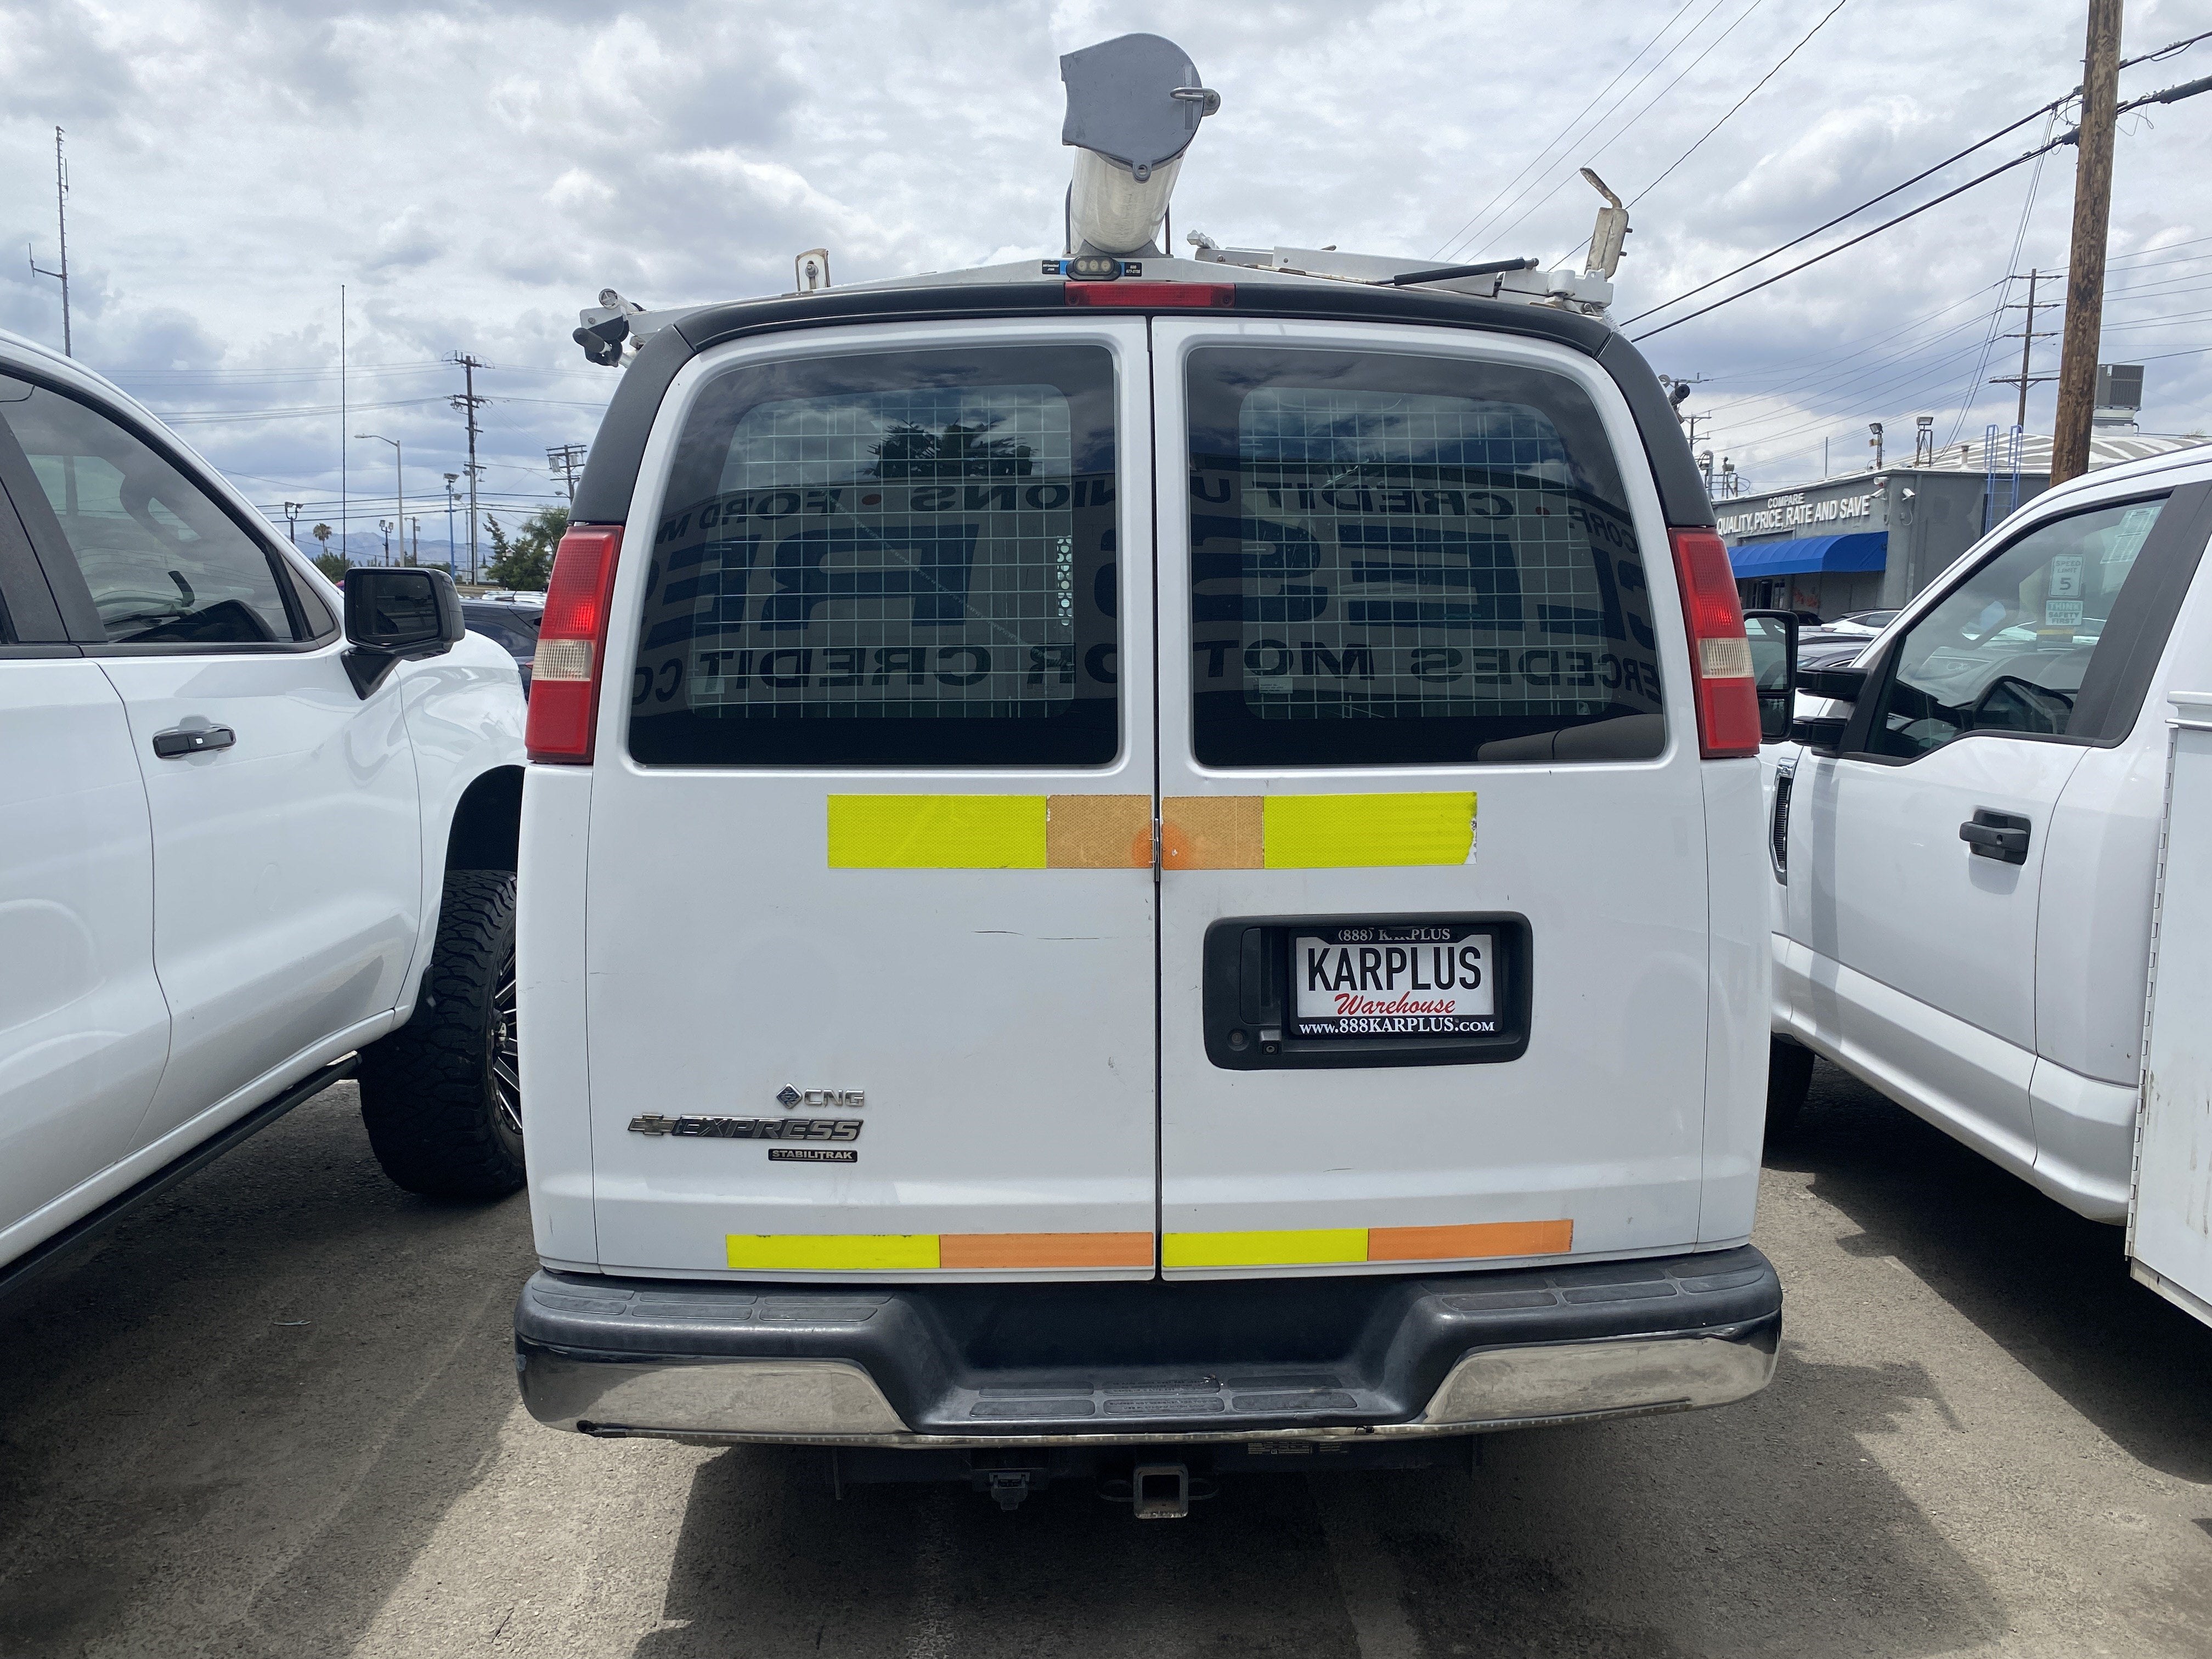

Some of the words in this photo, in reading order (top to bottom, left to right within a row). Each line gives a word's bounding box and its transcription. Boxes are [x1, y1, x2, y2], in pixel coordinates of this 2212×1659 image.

[1768, 493, 1804, 509] COMPARE
[1754, 508, 1783, 531] PRICE,
[1786, 504, 1813, 526] RATE
[1814, 500, 1838, 522] AND
[1840, 495, 1871, 519] SAVE
[2059, 577, 2071, 590] 5
[2047, 602, 2081, 611] THINK
[1338, 928, 1373, 941] (888)
[1378, 928, 1451, 941] KPLUS
[1308, 946, 1481, 991] KARPLUS
[1334, 991, 1455, 1015] Warehouse
[804, 1088, 865, 1107] CNG
[680, 1117, 861, 1141] EXPRESS
[772, 1149, 854, 1160] STABILITRAK
